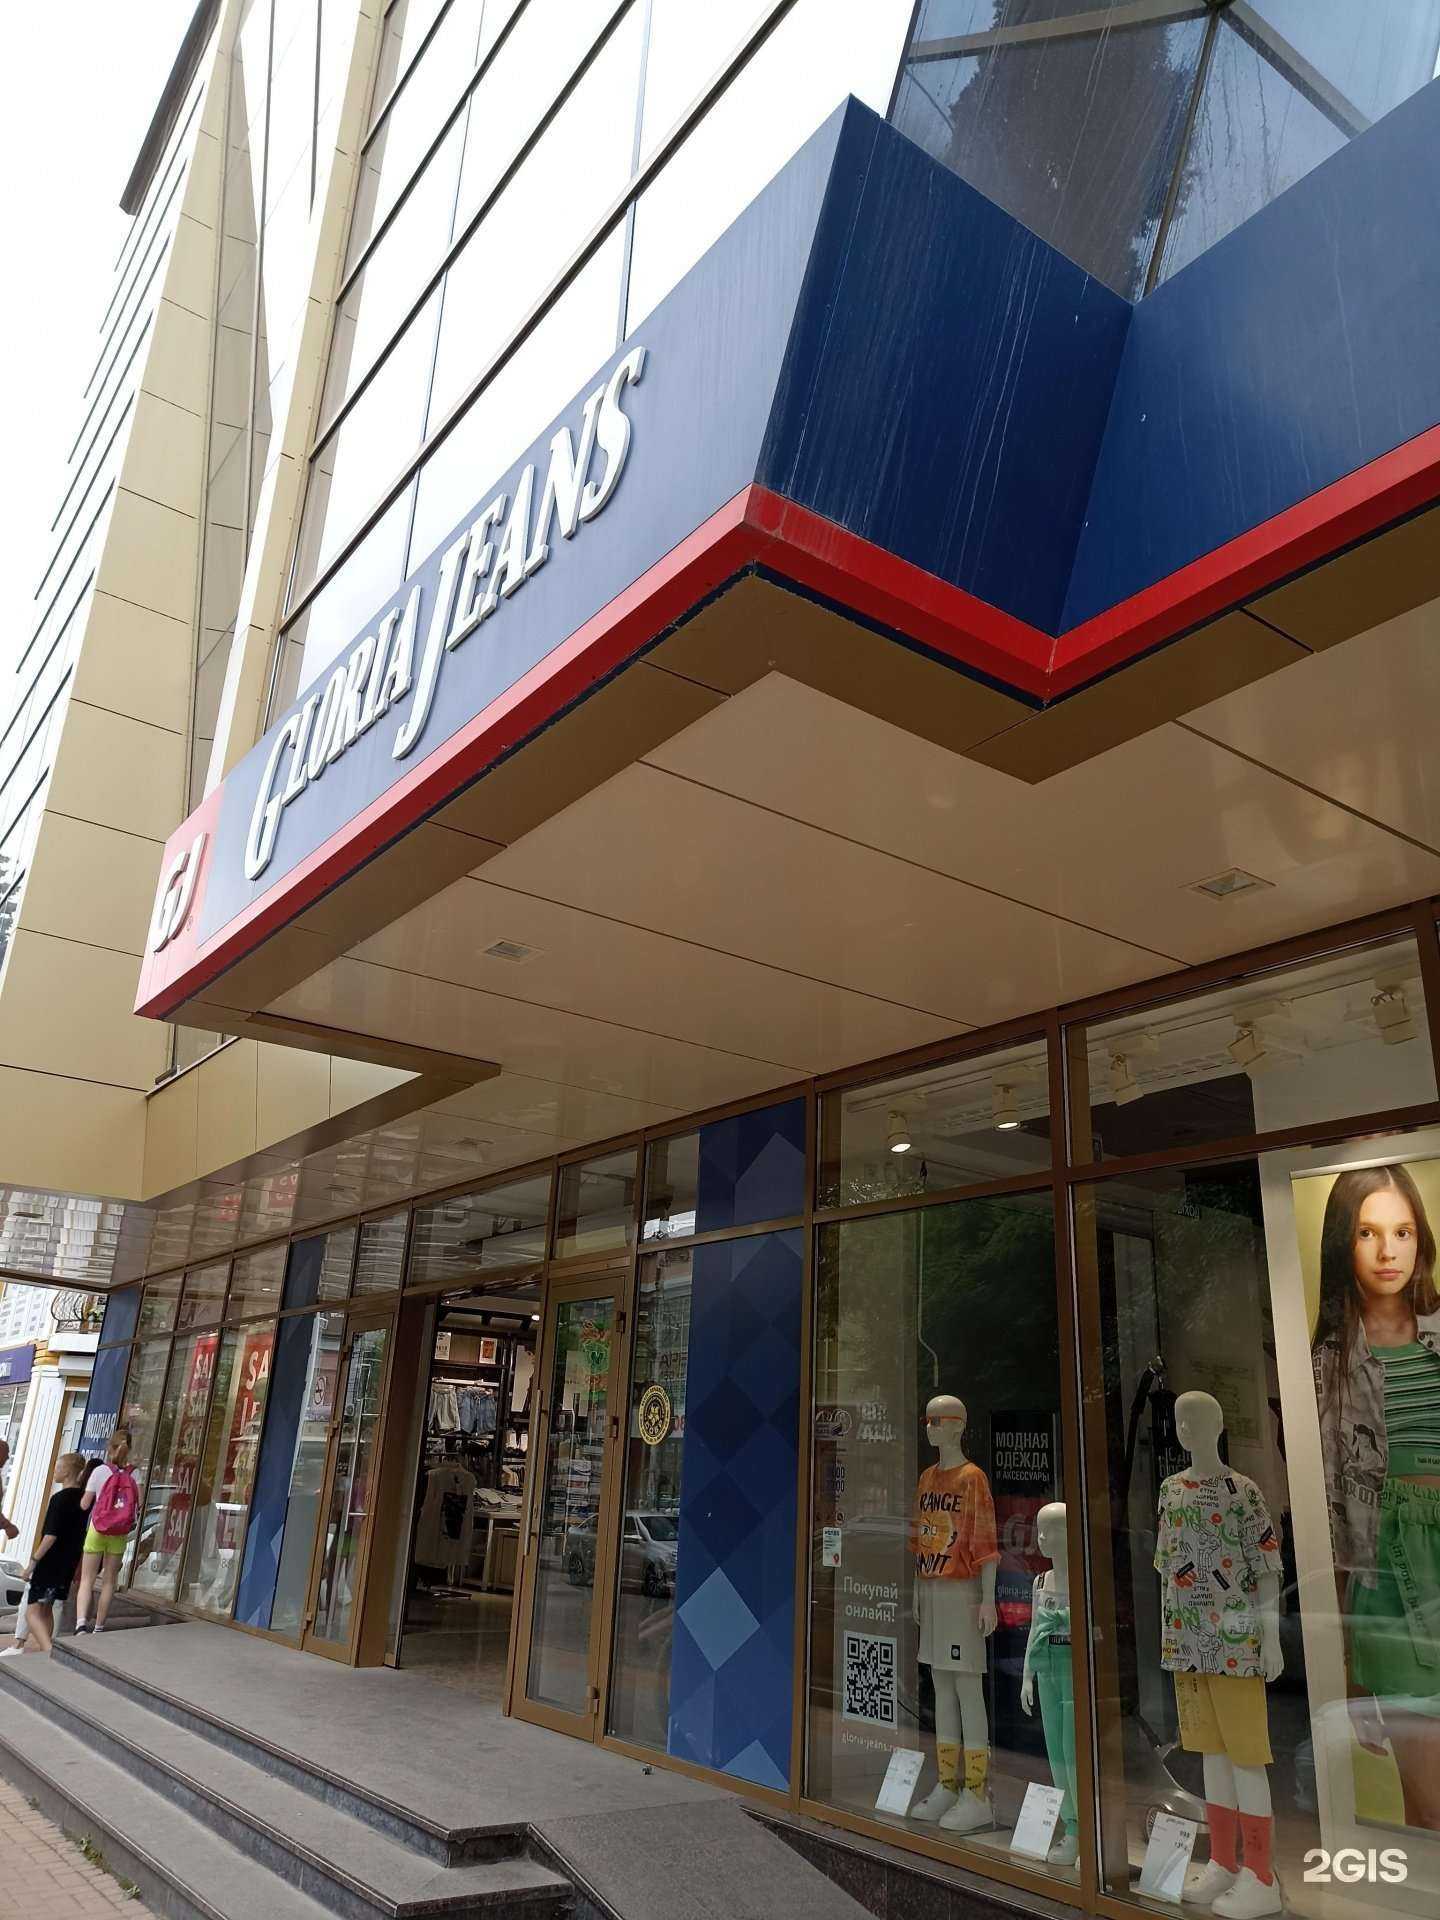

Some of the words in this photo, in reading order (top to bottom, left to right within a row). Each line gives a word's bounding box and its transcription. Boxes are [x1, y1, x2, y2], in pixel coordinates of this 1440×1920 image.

[244, 584, 423, 881] GLORIA
[391, 347, 647, 761] JEANS
[995, 1431, 1049, 1451] МОДНАЯ
[996, 1451, 1049, 1471] ОДЕЖДА
[1002, 1471, 1050, 1482] АКСЕССУАРЫ
[843, 1576, 899, 1600] Покупай
[845, 1601, 896, 1623] онлайн!
